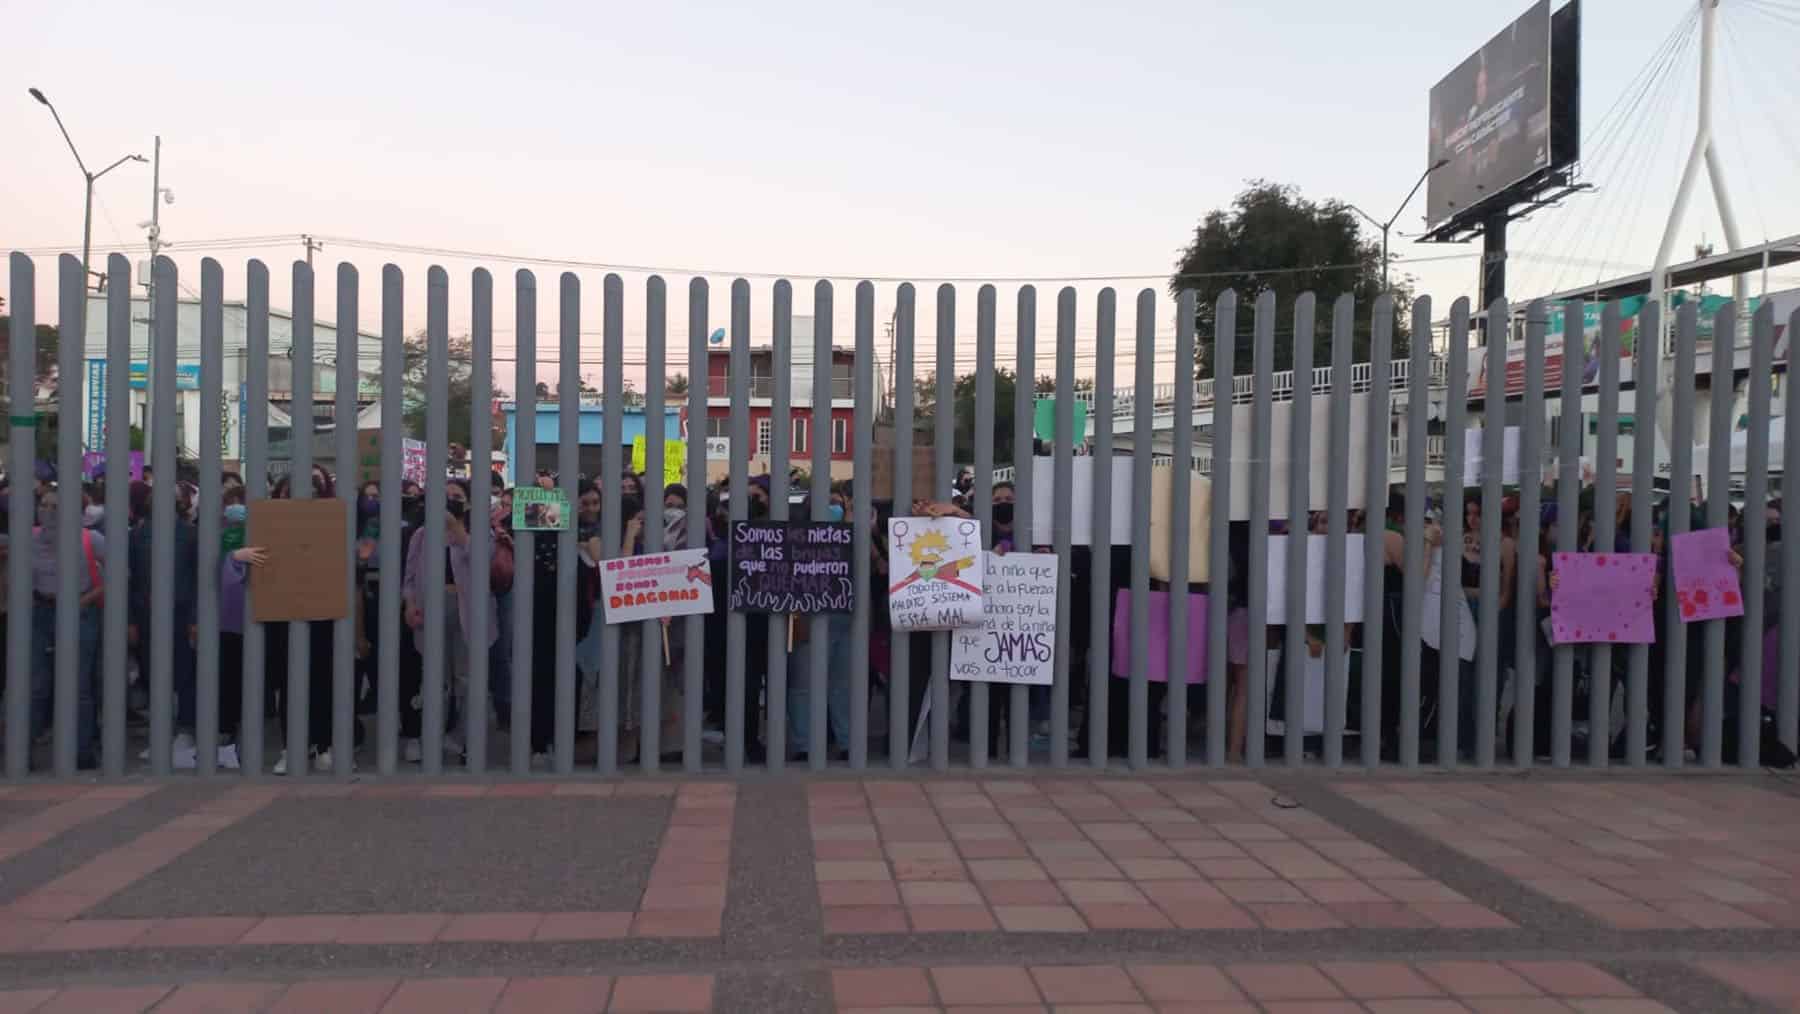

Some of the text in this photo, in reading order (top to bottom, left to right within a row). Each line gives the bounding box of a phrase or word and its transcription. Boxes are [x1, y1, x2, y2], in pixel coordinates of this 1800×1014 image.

[736, 522, 783, 543] Somos
[808, 525, 851, 543] nietas
[761, 544, 783, 560] las
[739, 560, 767, 576] que
[793, 560, 849, 576] pudieron
[1029, 566, 1053, 580] que
[931, 592, 971, 604] SISTEMA
[1038, 600, 1050, 615] la
[938, 608, 969, 626] MAL
[984, 631, 1051, 663] JAMAS
[955, 660, 1040, 678] vas a tocar
